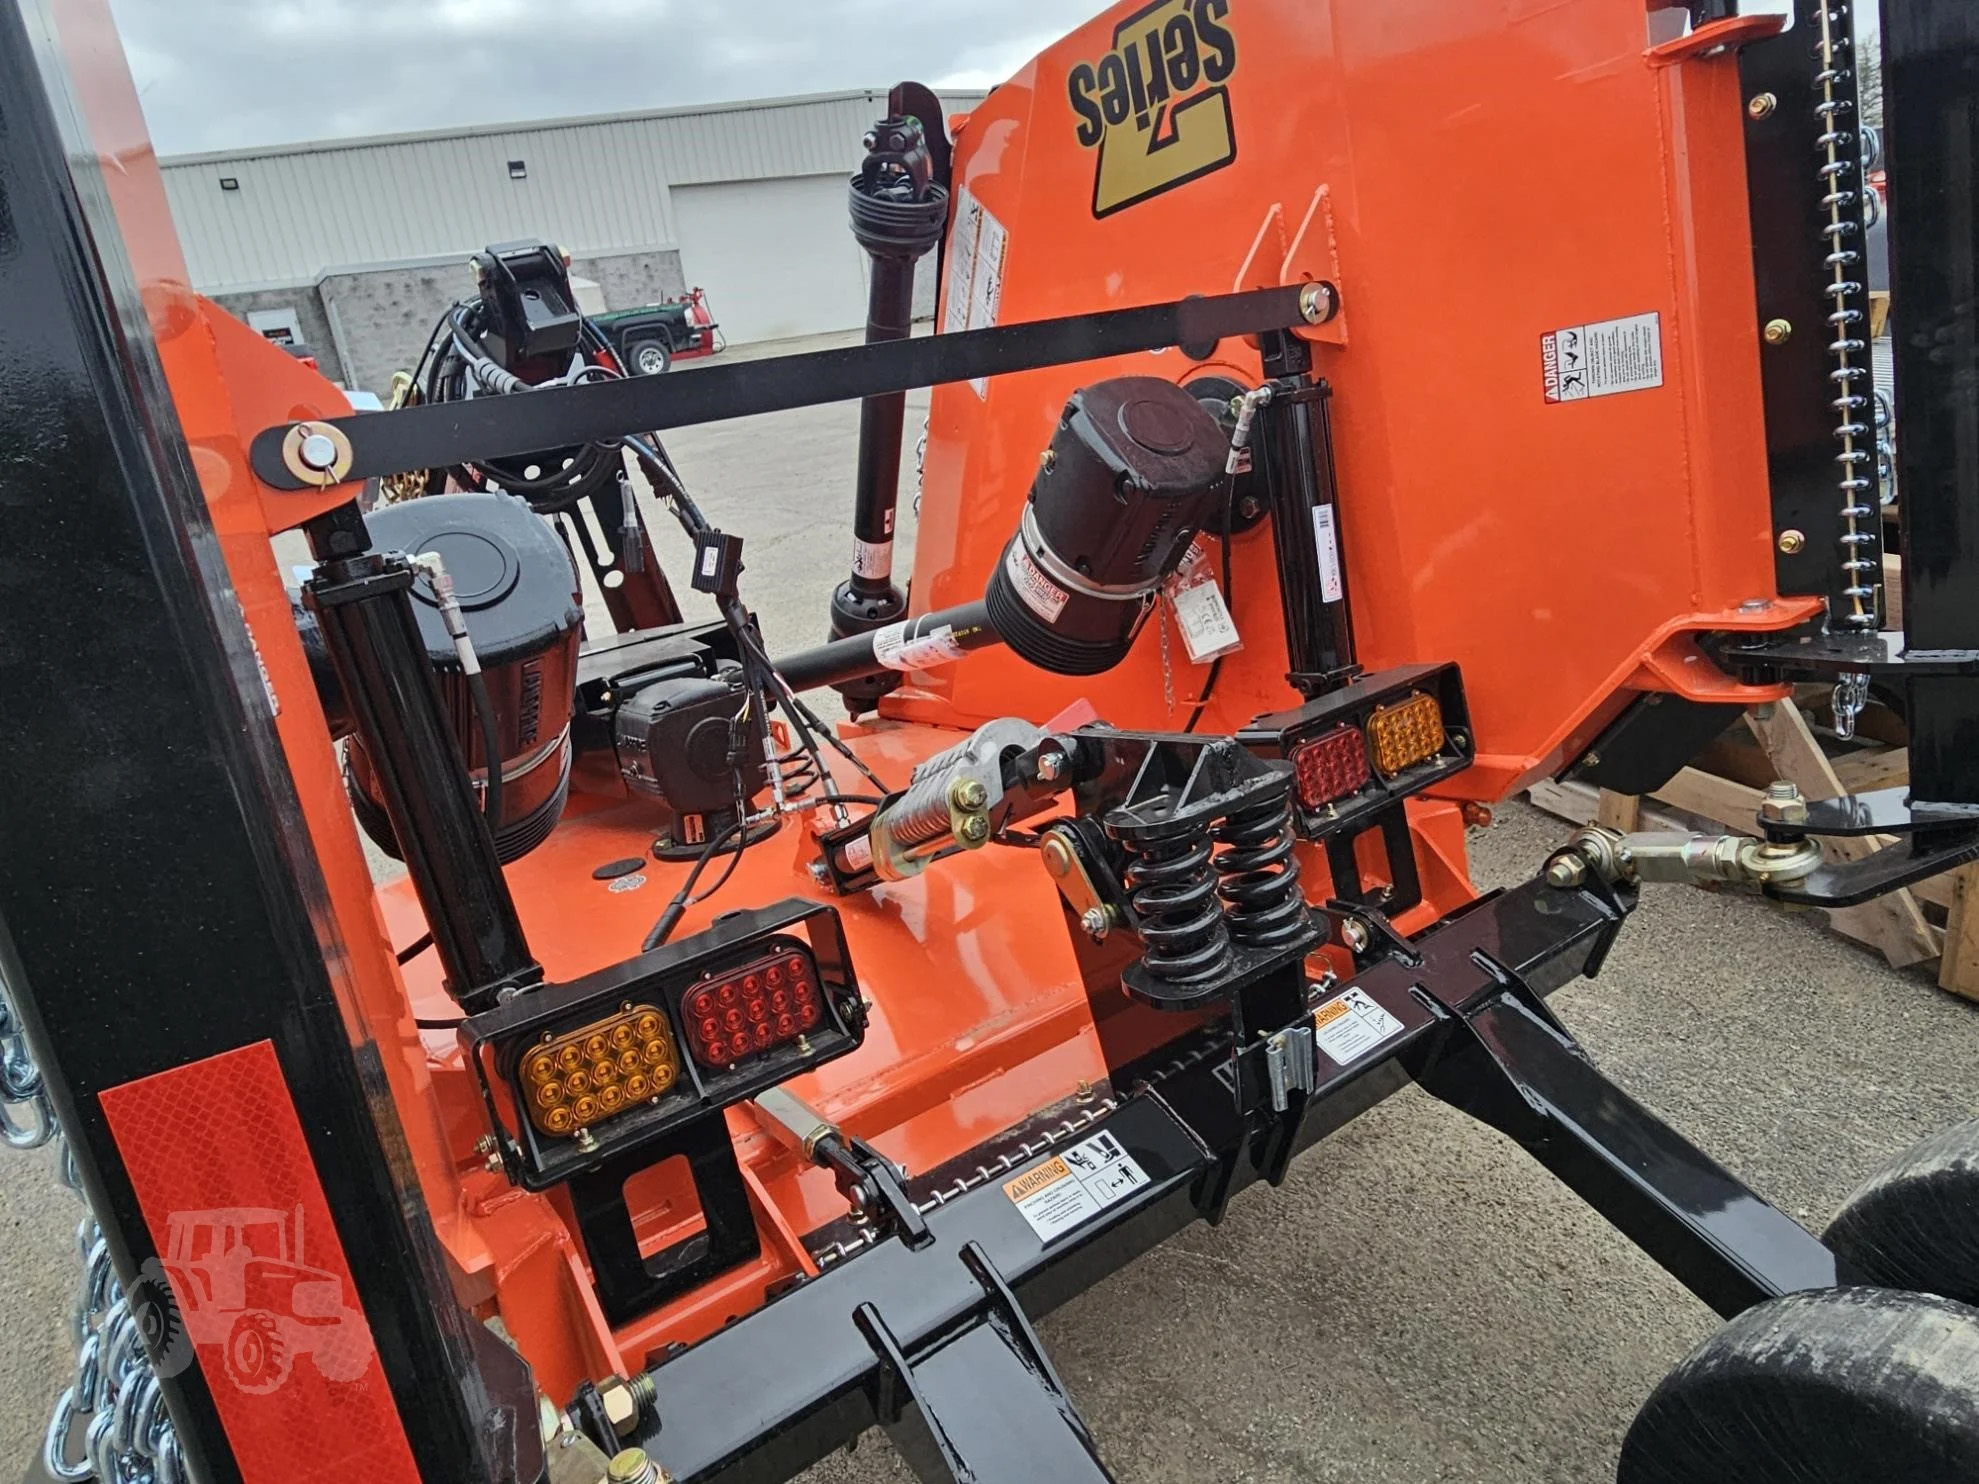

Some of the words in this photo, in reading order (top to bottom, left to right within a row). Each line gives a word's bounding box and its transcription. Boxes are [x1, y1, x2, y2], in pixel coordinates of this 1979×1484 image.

[1068, 0, 1236, 147] Series
[1542, 335, 1559, 388] DANGER
[1028, 565, 1064, 601] DANGER
[1019, 1160, 1065, 1191] WARNING
